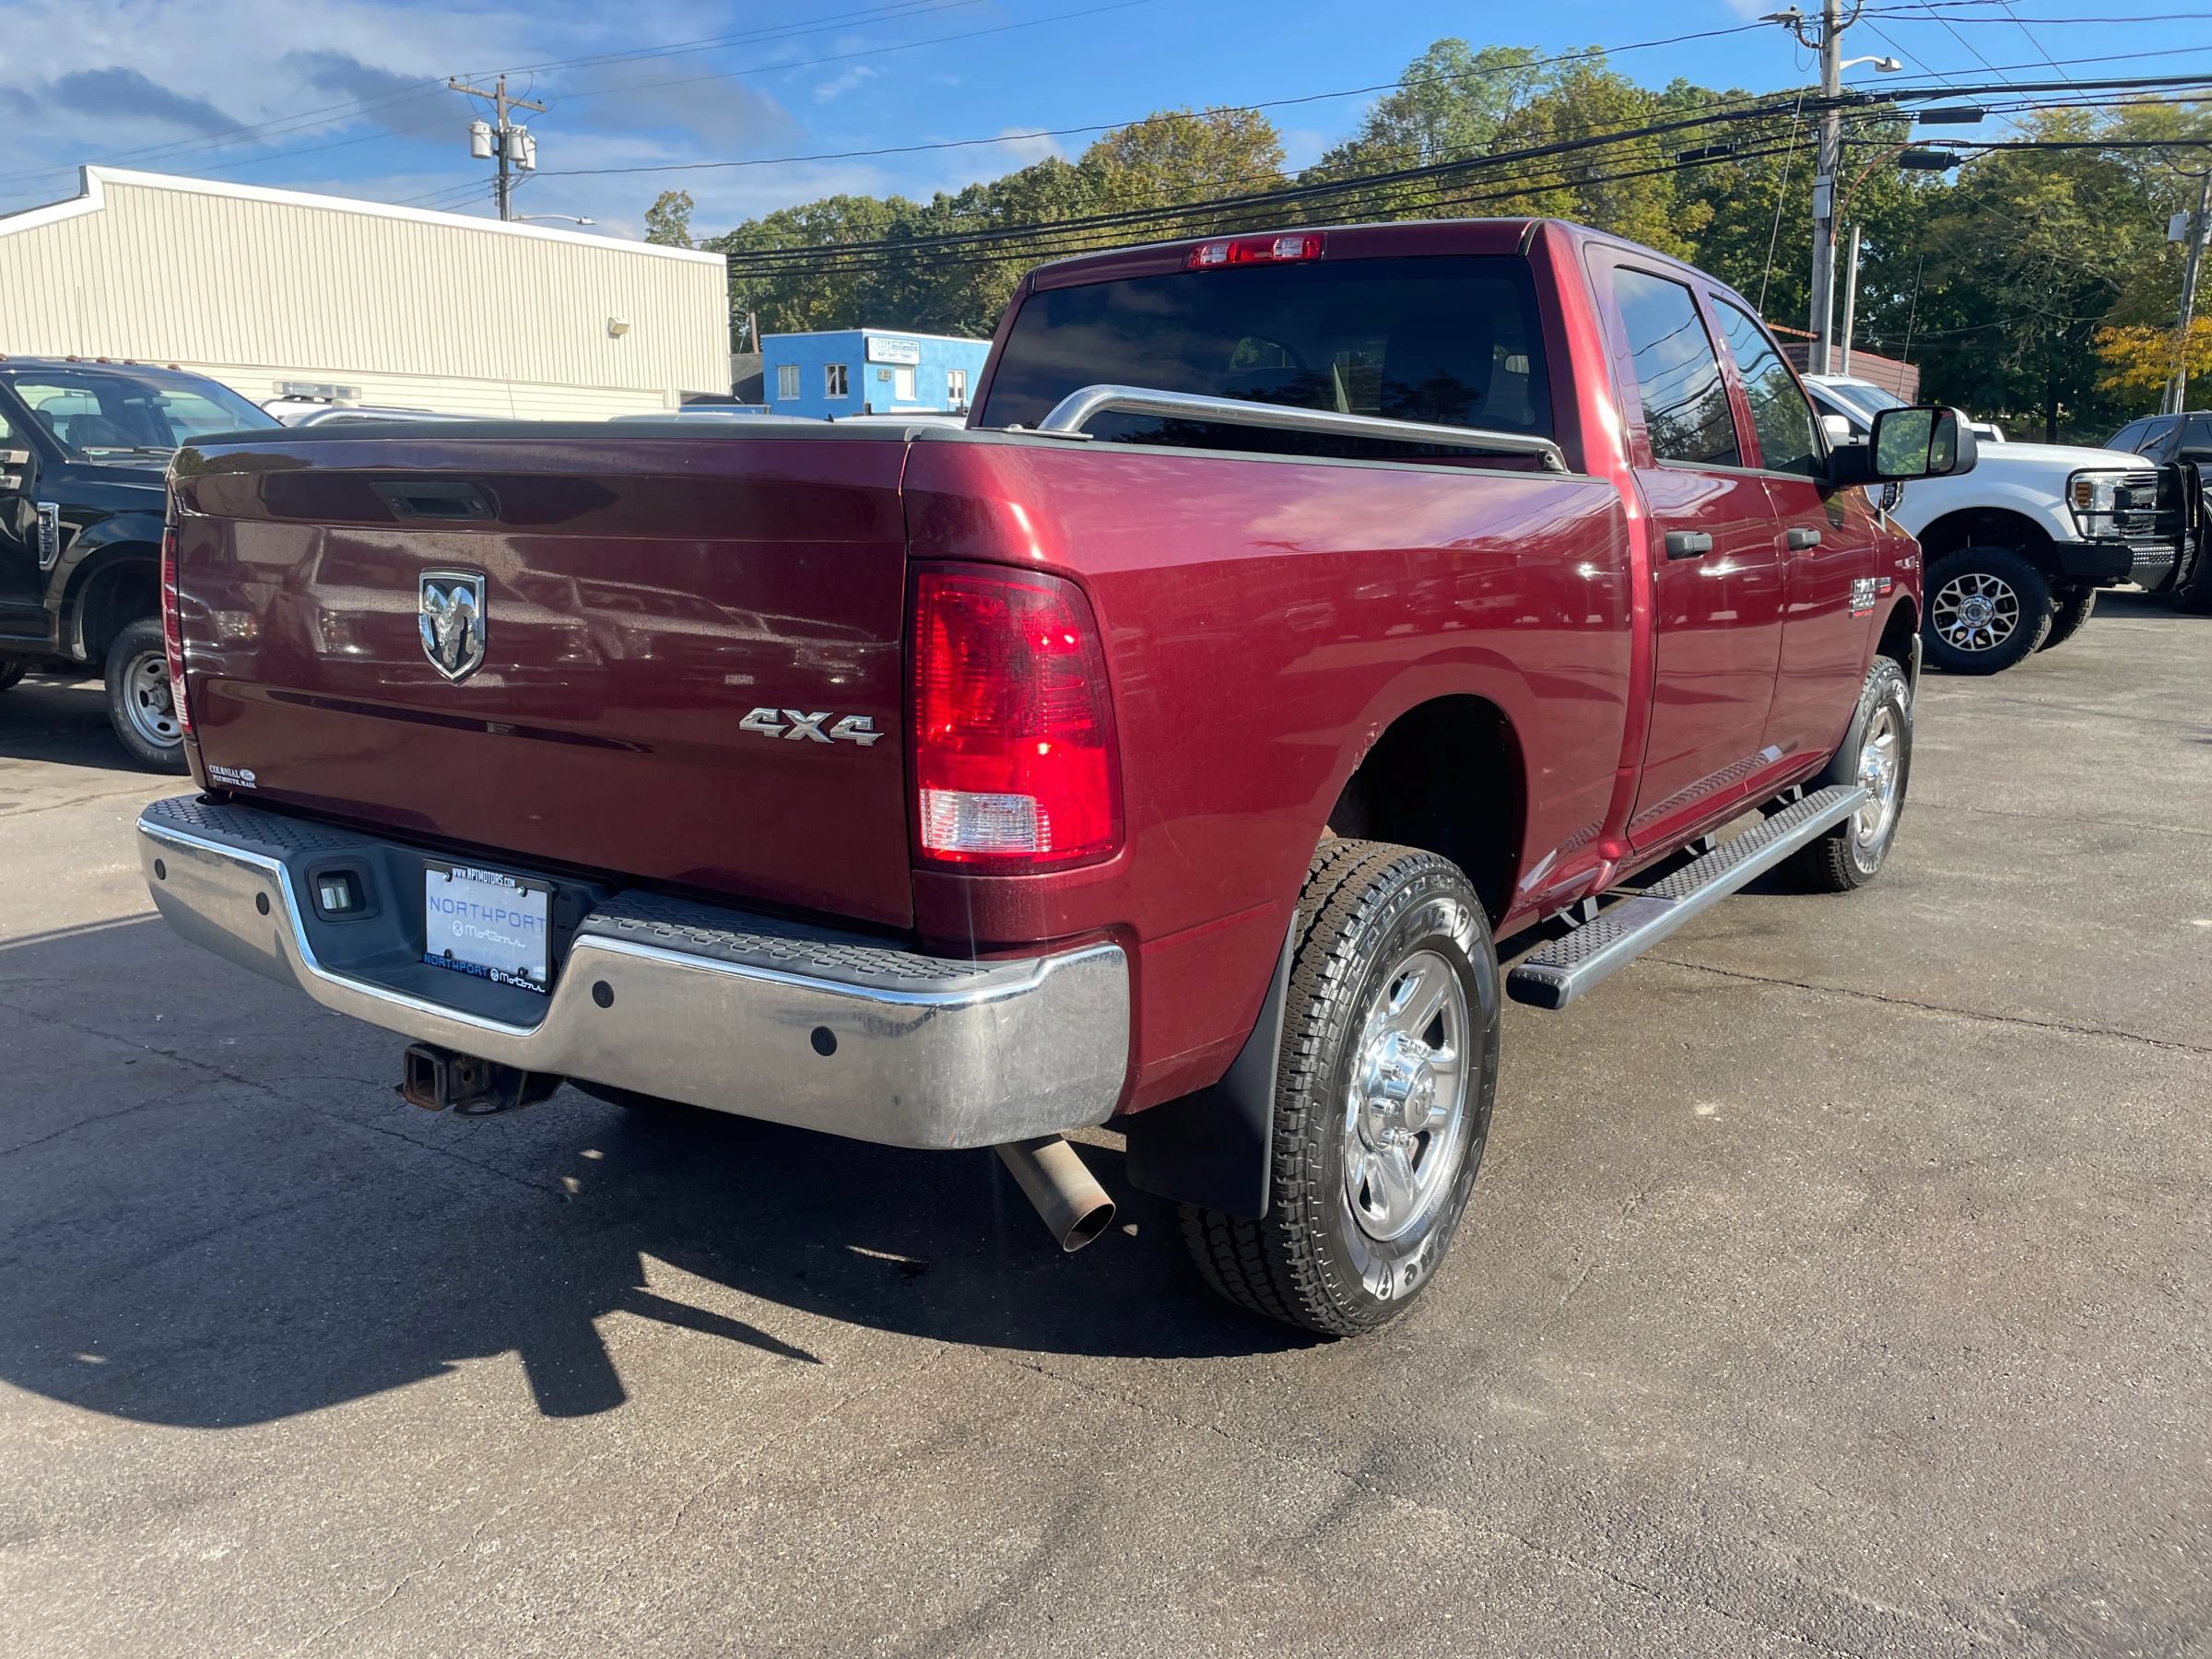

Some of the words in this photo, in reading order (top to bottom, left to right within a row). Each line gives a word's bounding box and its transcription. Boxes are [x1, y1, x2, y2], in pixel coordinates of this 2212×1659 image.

[208, 764, 241, 779] COLONIAL
[429, 896, 547, 933] NORTHPORT
[424, 954, 488, 977] NORTHPORT
